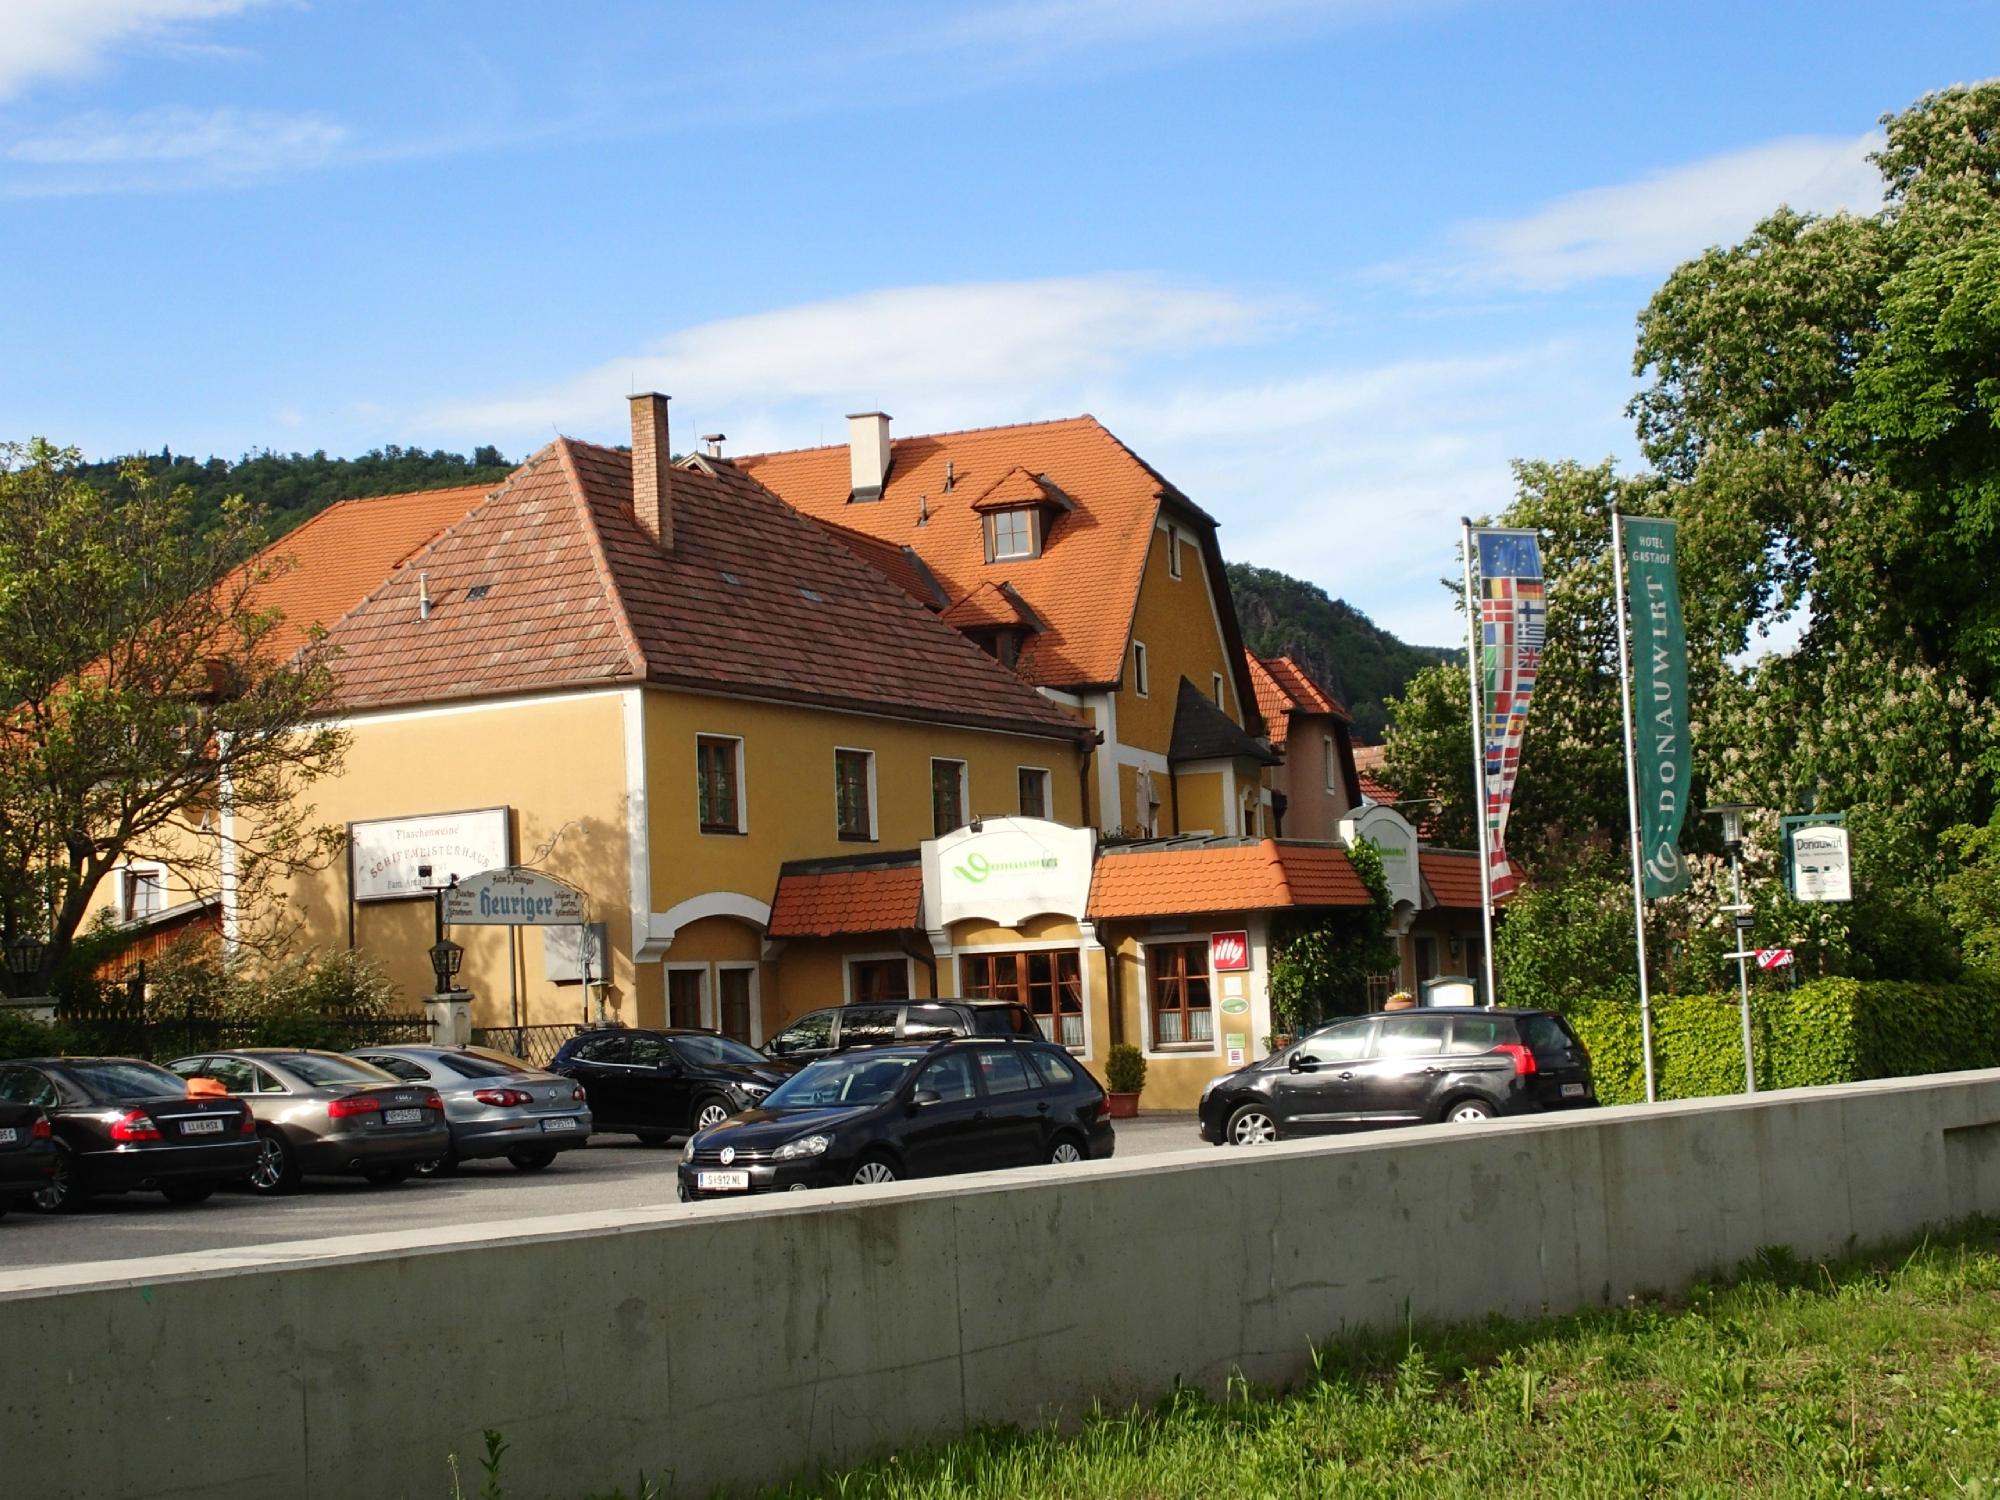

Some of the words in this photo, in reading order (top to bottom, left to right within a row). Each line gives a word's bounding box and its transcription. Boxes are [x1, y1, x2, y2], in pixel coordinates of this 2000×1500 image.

[1639, 535, 1666, 549] HOTEL
[1632, 551, 1671, 565] GASTHOF
[1645, 575, 1678, 813] DONAUWIRT
[1796, 836, 1843, 850] Donauwirt
[480, 886, 554, 923] Heuriger
[1215, 938, 1243, 965] illy
